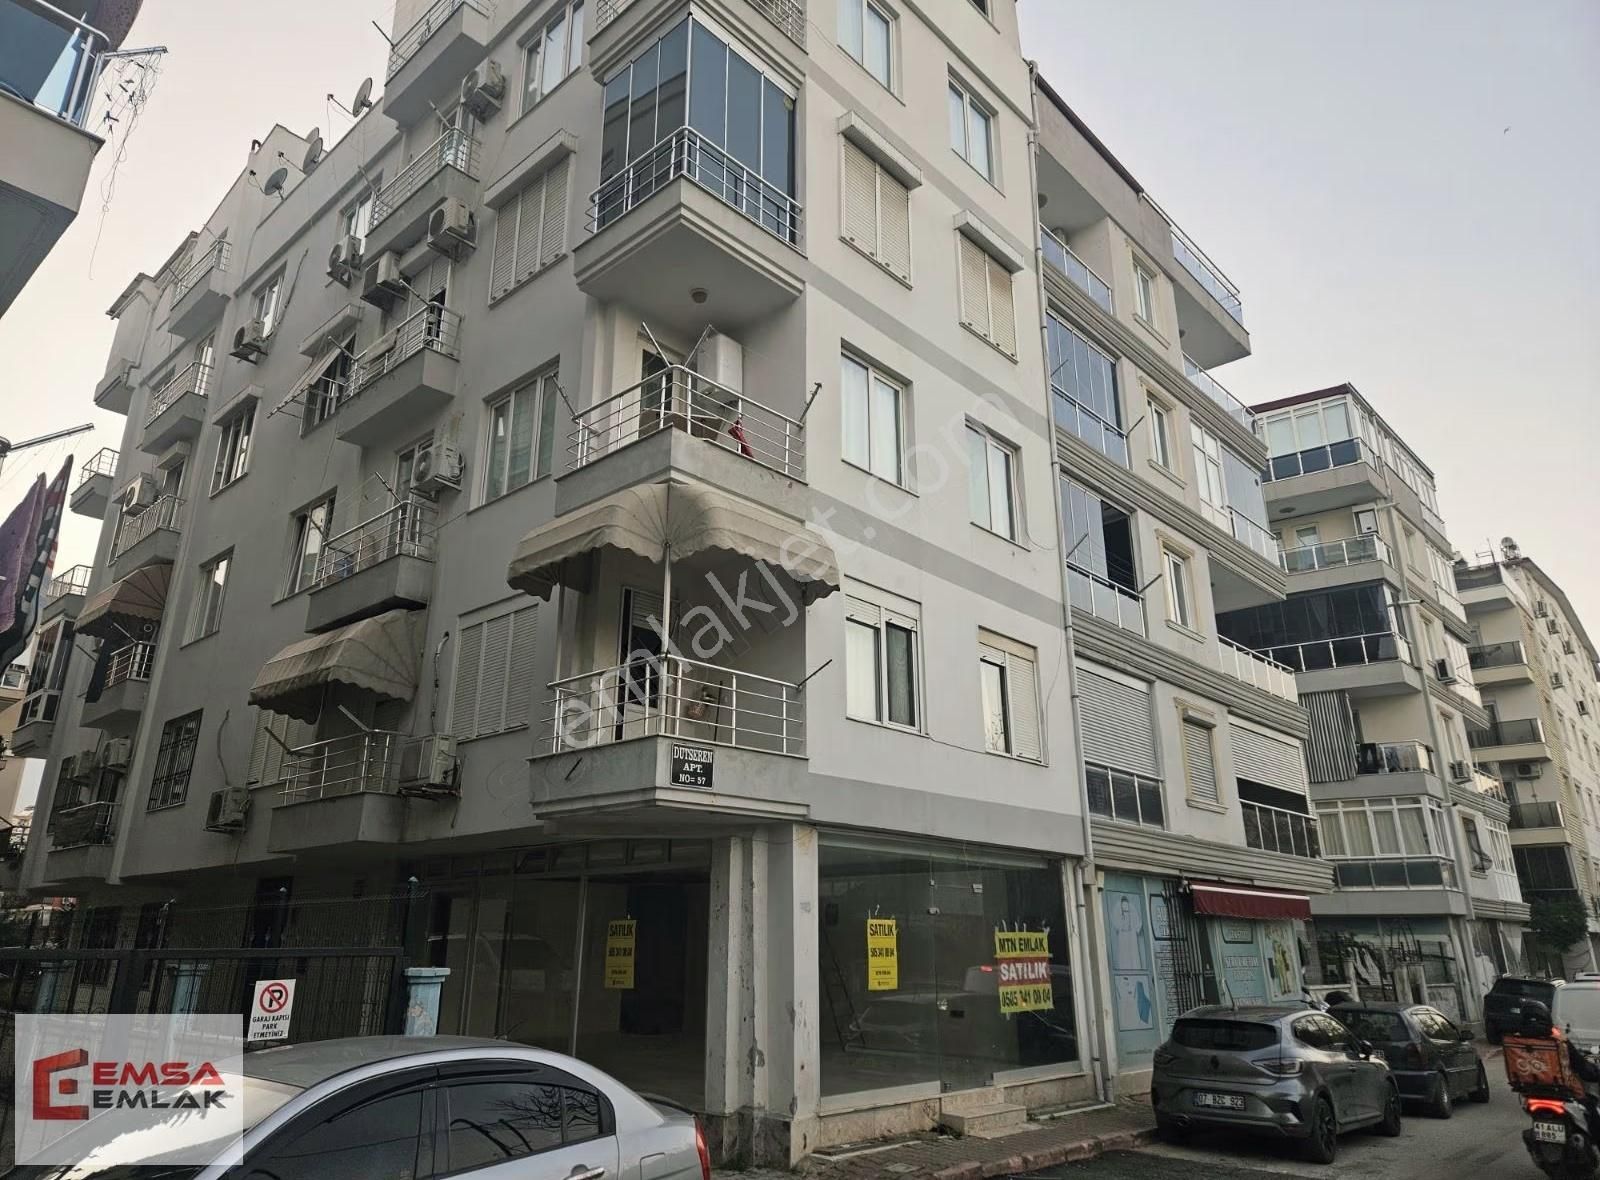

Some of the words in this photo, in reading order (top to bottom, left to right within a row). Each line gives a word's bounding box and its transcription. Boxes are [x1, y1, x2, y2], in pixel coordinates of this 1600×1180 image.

[869, 923, 894, 937] SATILIK
[999, 937, 1017, 953] MTN
[1019, 938, 1046, 952] EMLAK
[1000, 961, 1047, 981] SATILIK
